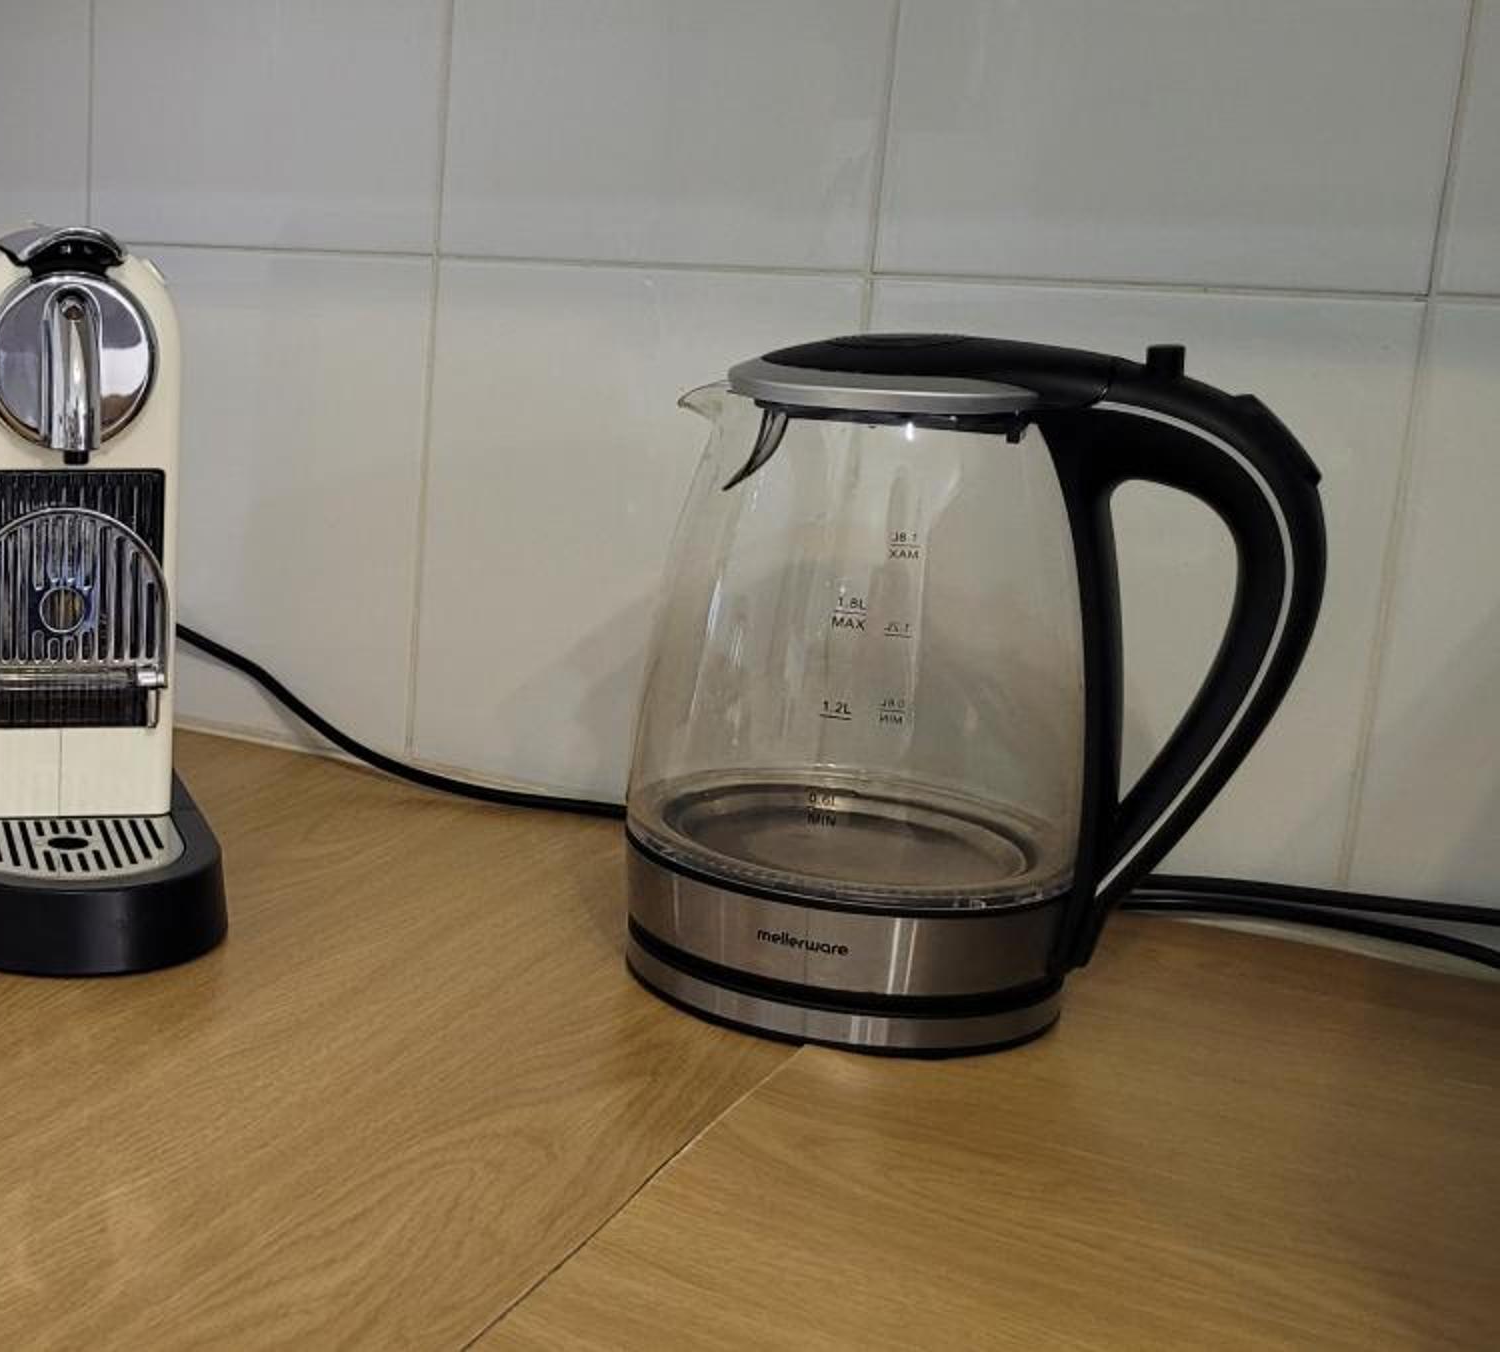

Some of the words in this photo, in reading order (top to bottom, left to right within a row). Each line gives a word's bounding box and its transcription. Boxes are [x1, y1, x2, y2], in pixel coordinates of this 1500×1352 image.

[838, 596, 867, 611] 1.8L
[831, 615, 867, 632] MAX
[822, 700, 852, 715] 1.2L
[806, 812, 837, 828] MIN
[756, 928, 850, 956] mellerware
